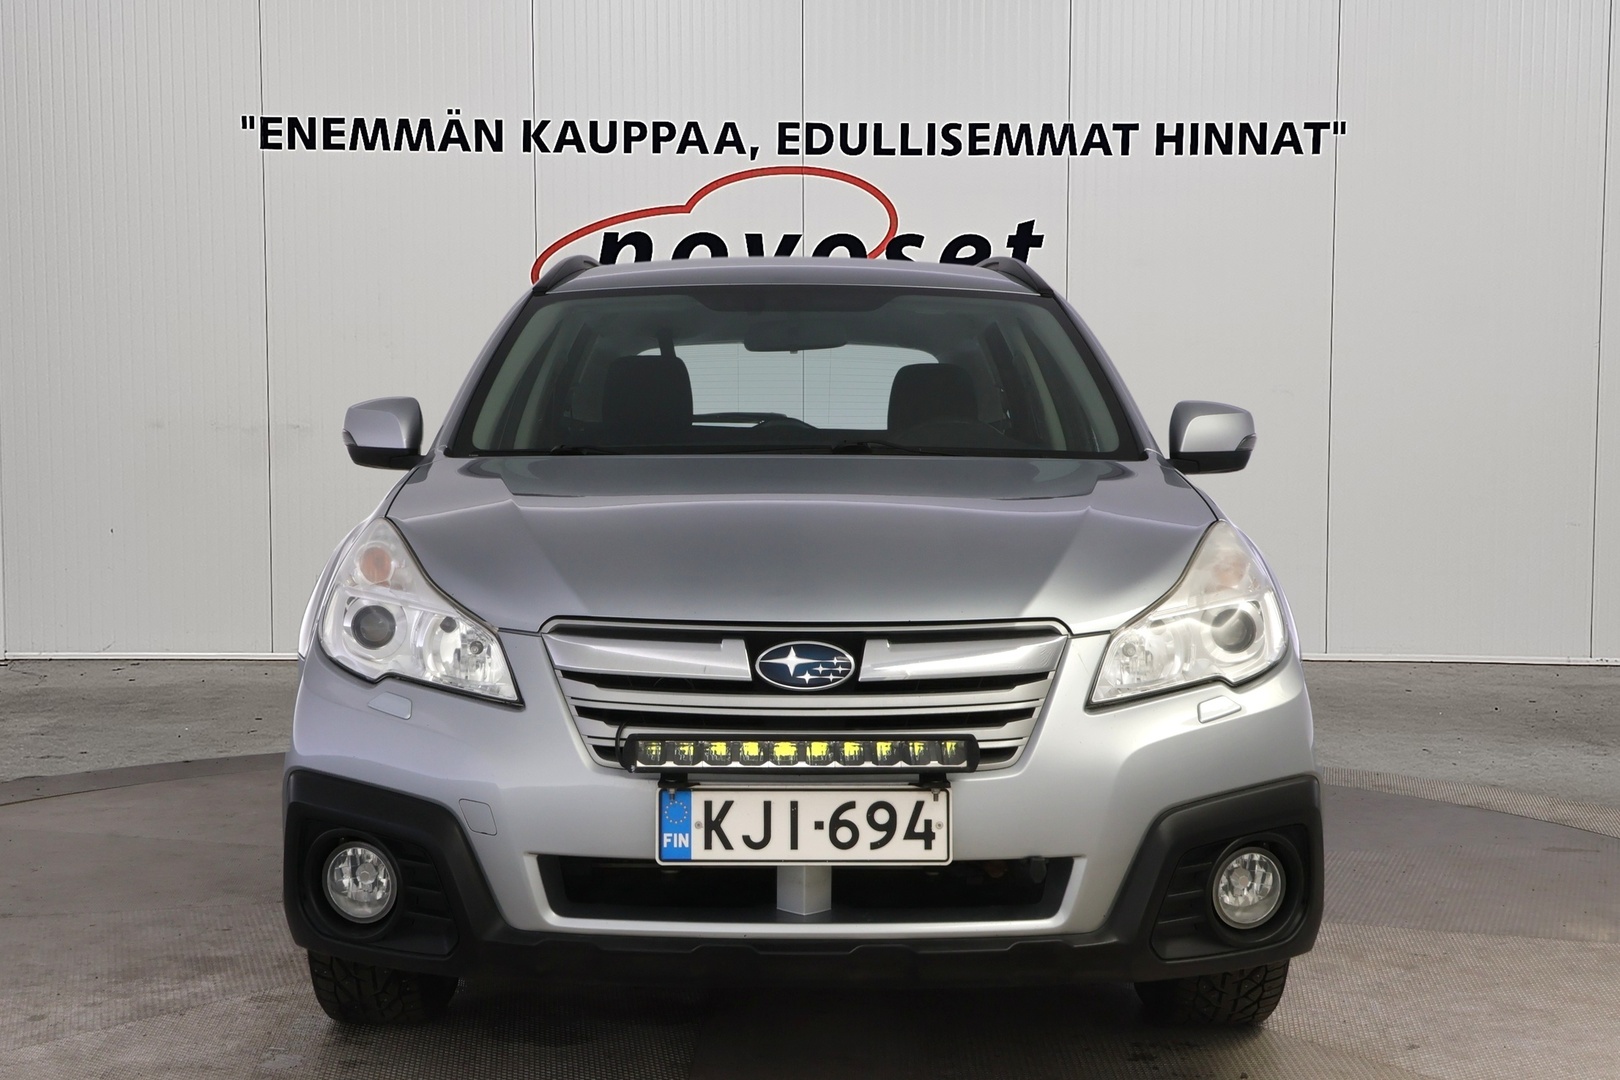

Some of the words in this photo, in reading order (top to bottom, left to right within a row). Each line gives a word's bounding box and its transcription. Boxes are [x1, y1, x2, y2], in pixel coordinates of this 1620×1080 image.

[241, 108, 503, 153] "ENEMMÄN
[522, 120, 759, 161] KAUPPAA,
[777, 121, 1140, 156] EDULLISEMMAT
[1155, 120, 1347, 156] HINNAT"
[663, 832, 690, 849] FIN
